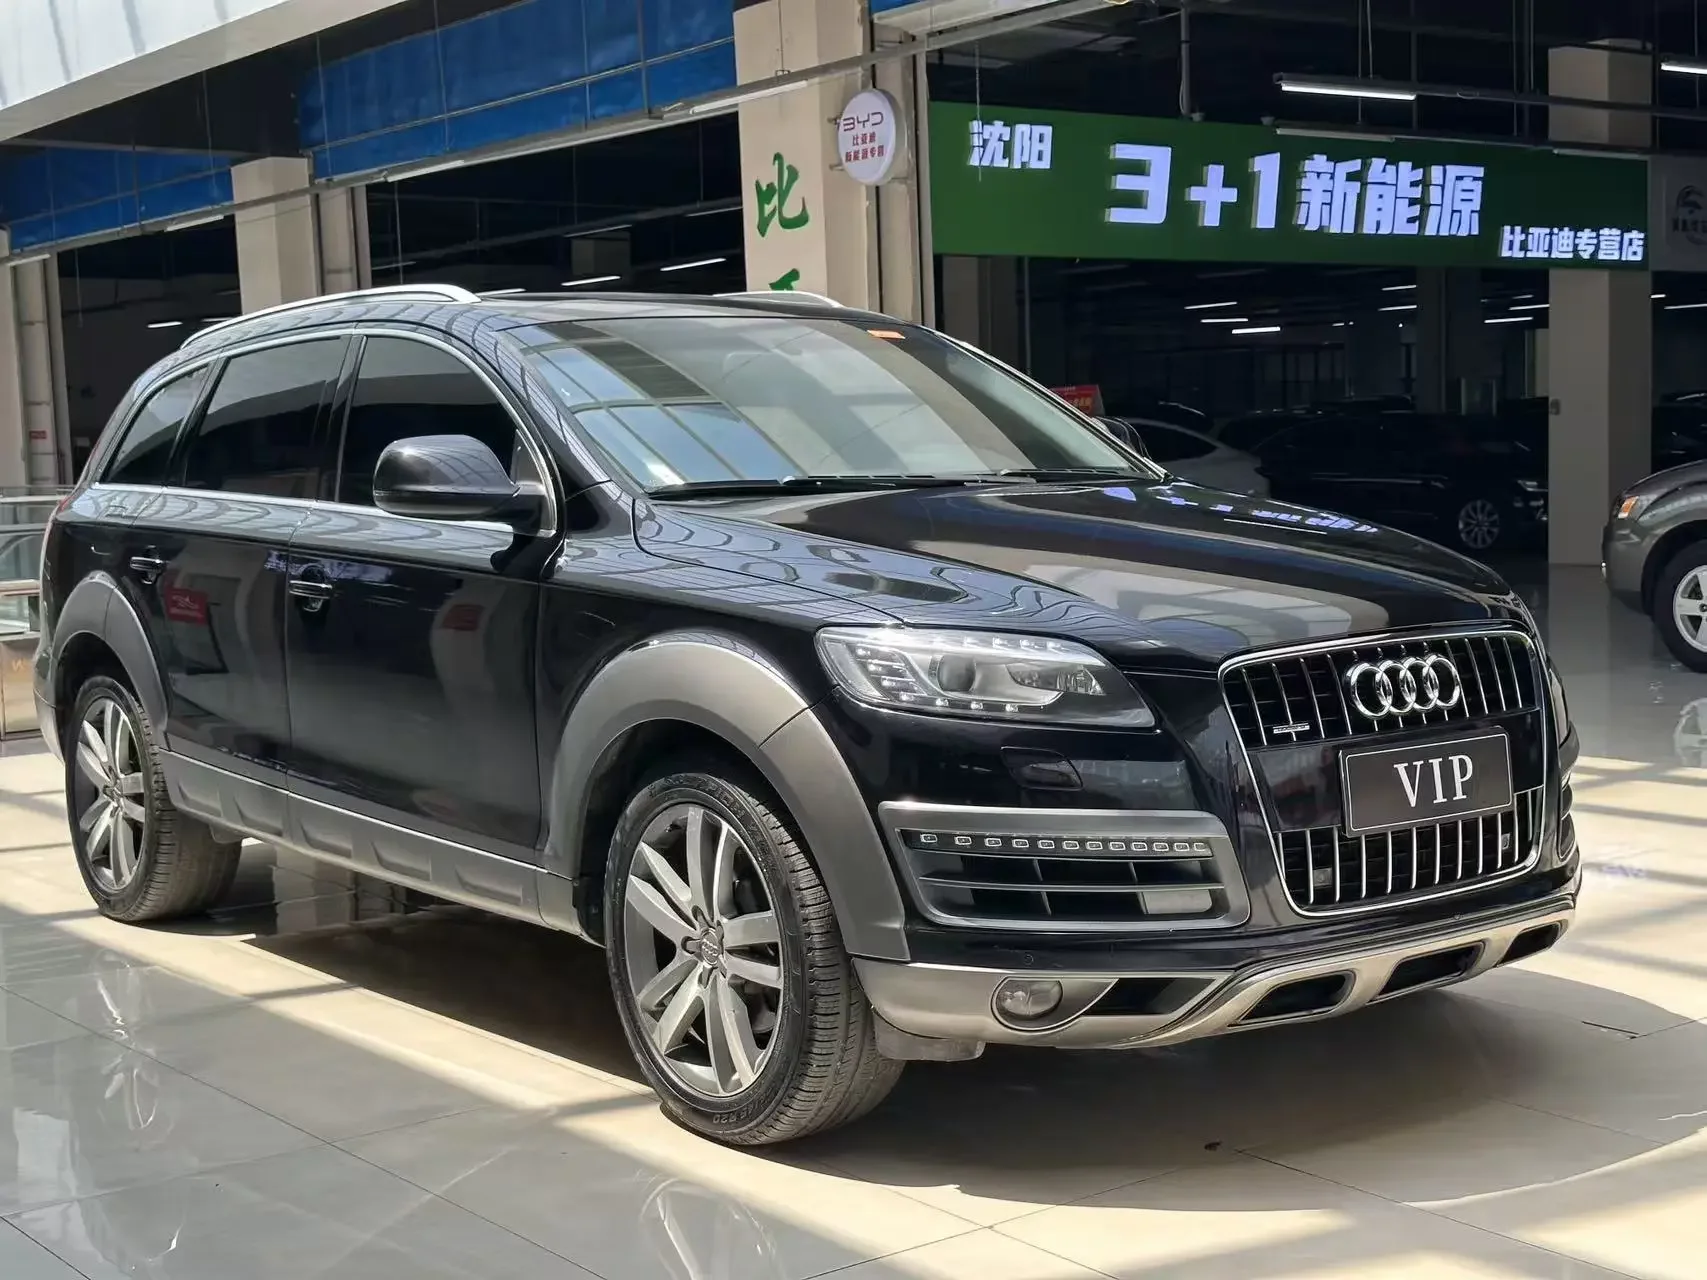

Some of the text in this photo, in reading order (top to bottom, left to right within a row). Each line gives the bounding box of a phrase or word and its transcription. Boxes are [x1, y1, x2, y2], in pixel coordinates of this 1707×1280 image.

[843, 111, 884, 132] BYD
[967, 119, 1053, 169] 沈阳
[1499, 225, 1645, 262] 比亚迪专营店
[1393, 754, 1474, 808] VIP
